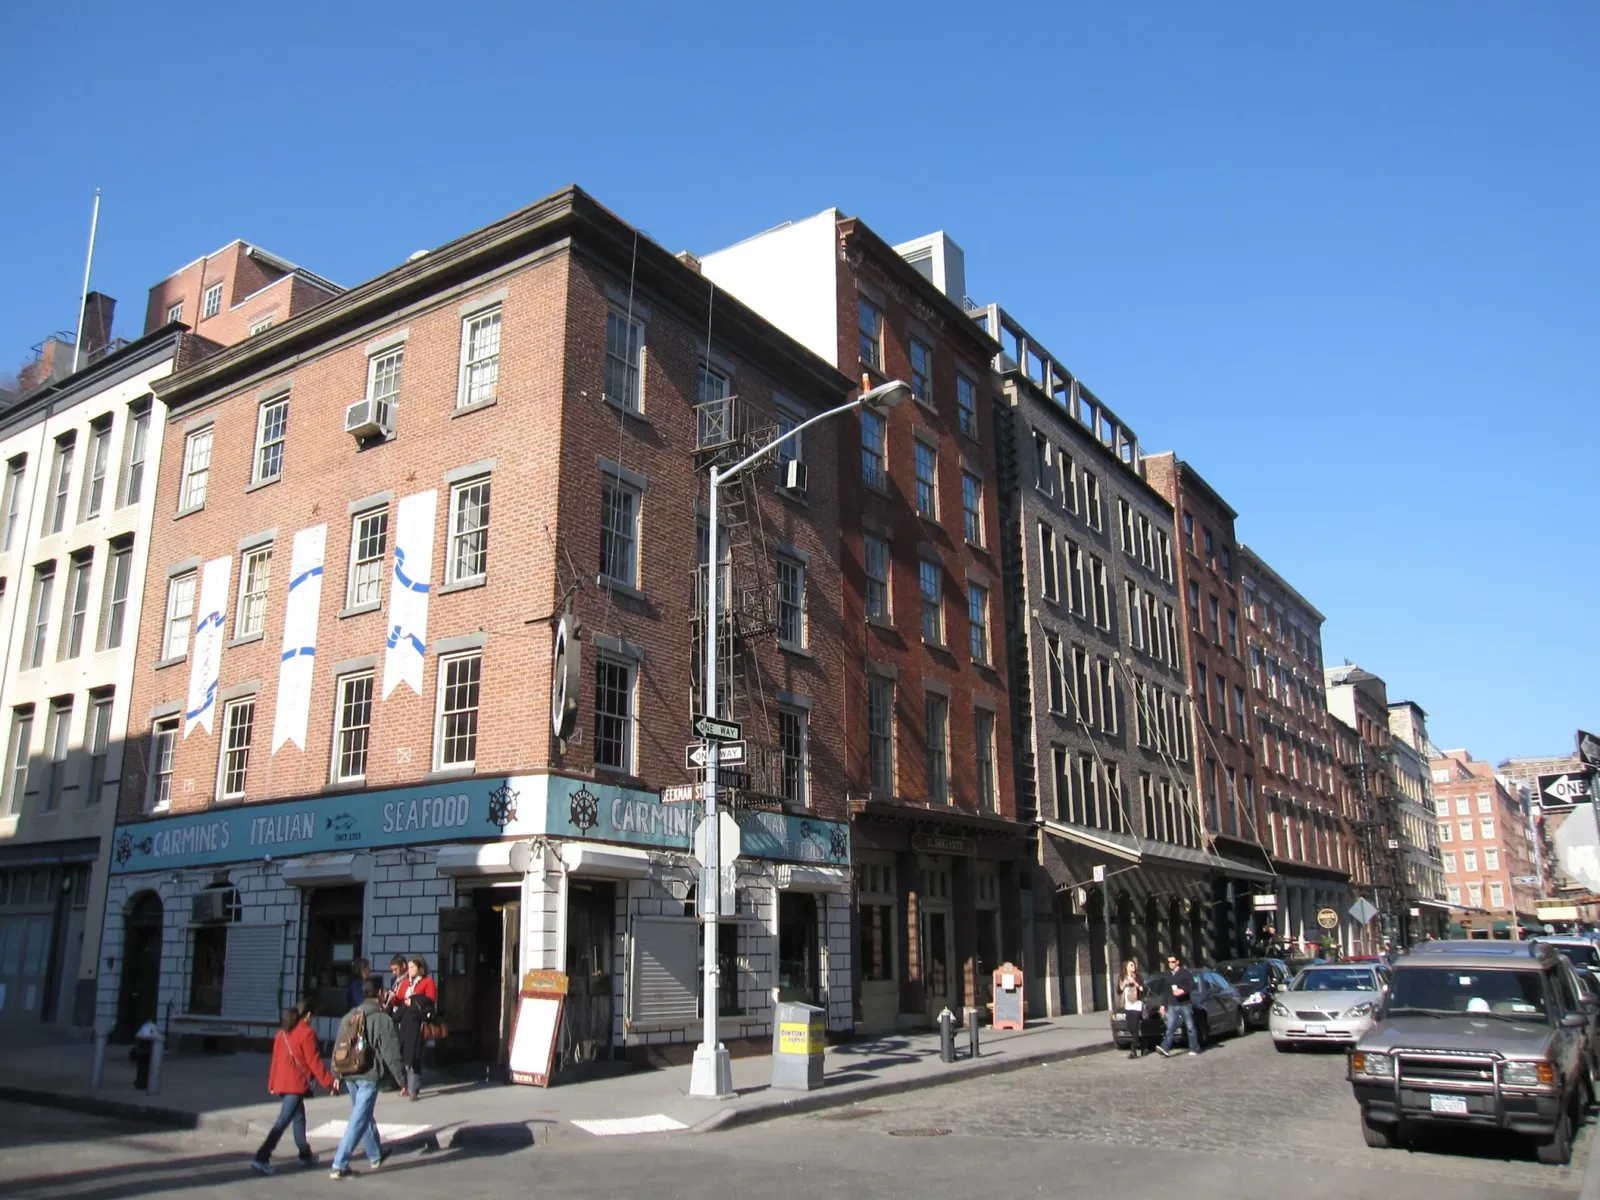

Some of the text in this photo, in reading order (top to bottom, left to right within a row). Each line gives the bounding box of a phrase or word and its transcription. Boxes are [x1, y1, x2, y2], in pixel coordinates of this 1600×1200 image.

[700, 722, 736, 736] ONE WAY
[695, 749, 738, 761] ON WAY
[720, 772, 748, 789] FRONT ST
[661, 784, 703, 802] BEEKMAN ST
[382, 794, 471, 833] SEAFOOD
[579, 820, 589, 829] BAR
[153, 818, 230, 857] CARMINE'S
[250, 812, 316, 846] ITALIAN
[334, 833, 348, 842] SINCE
[781, 839, 825, 859] SEAFOOD
